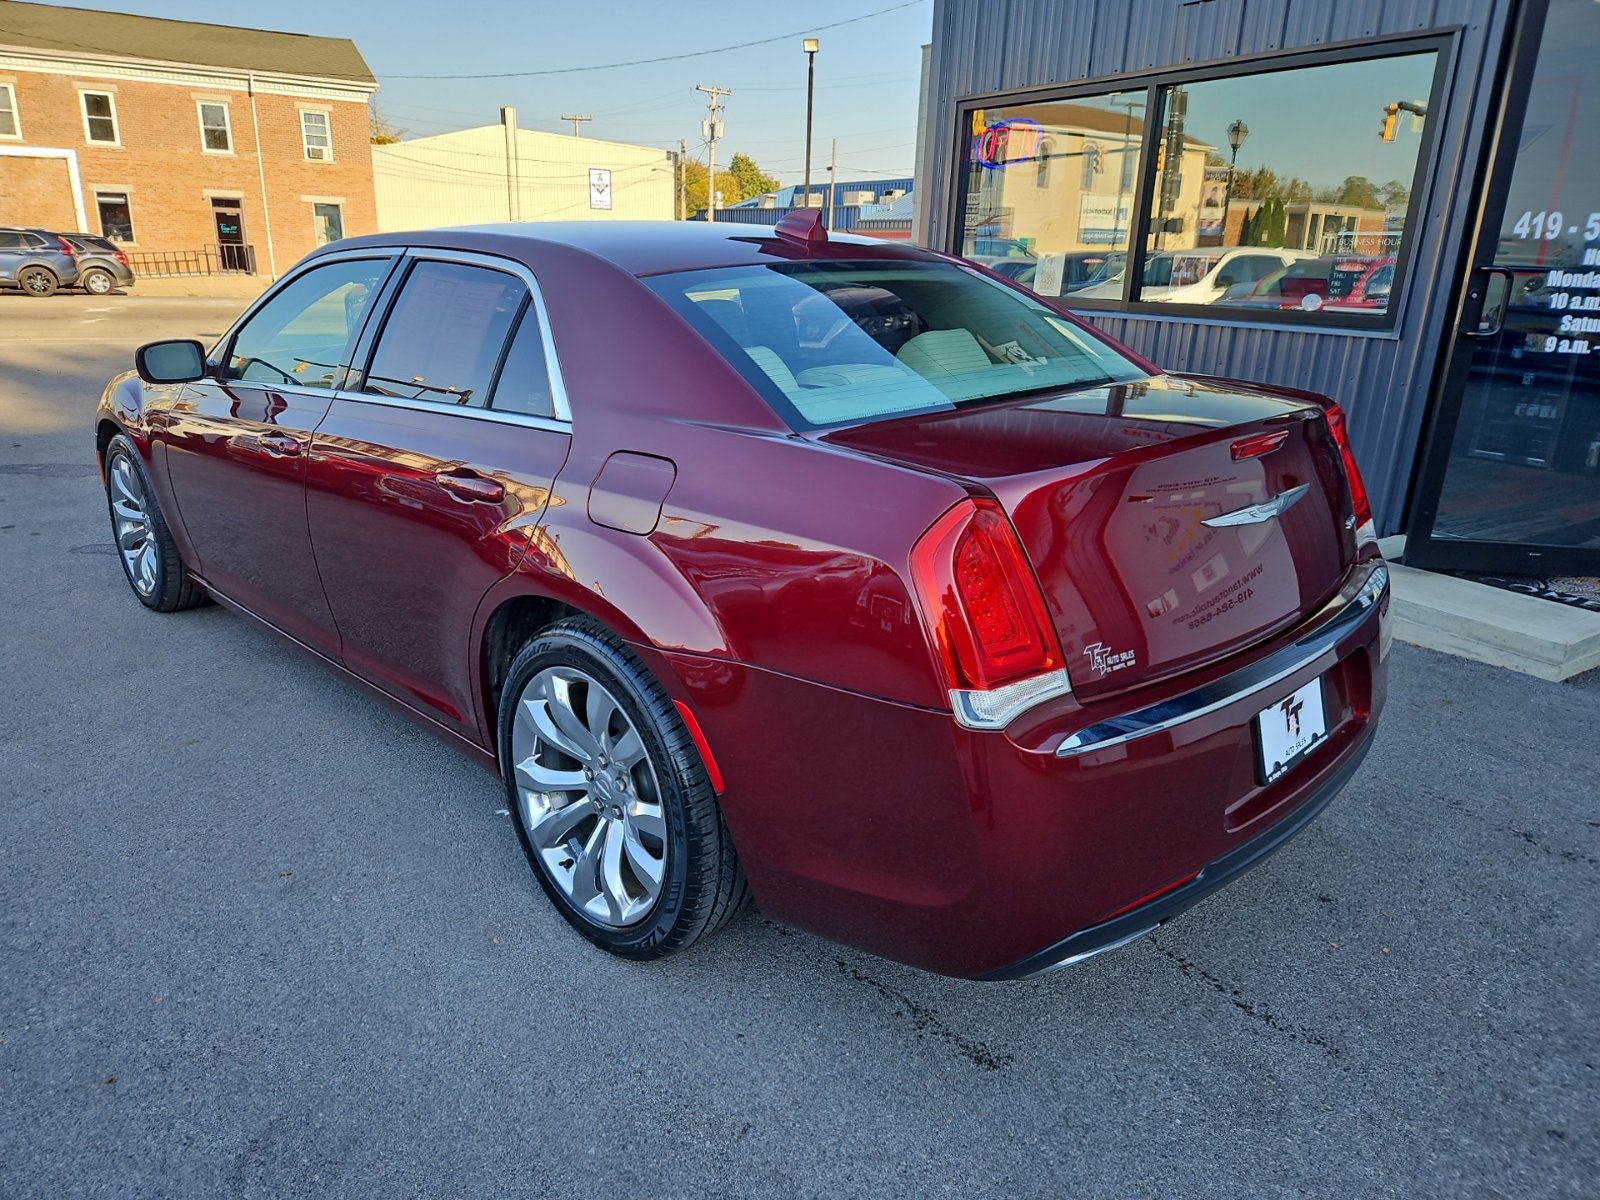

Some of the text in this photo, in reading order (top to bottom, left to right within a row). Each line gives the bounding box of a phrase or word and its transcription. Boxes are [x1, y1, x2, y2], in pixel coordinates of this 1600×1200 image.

[979, 126, 1039, 160] OPEN
[1513, 210, 1564, 240] 419
[1338, 238, 1375, 246] BUSINESS
[1550, 292, 1569, 310] 10
[1544, 335, 1558, 353] 9
